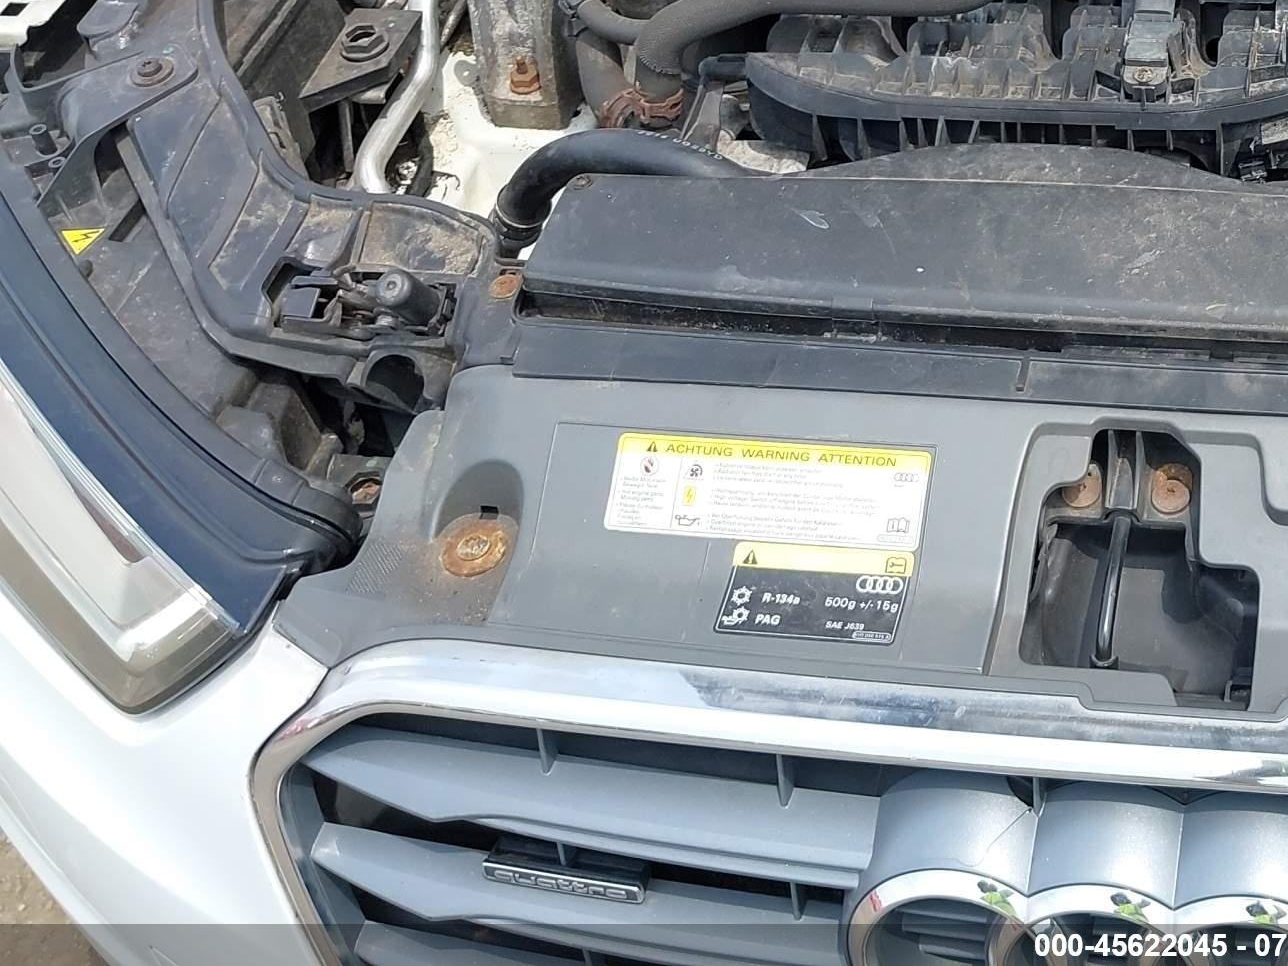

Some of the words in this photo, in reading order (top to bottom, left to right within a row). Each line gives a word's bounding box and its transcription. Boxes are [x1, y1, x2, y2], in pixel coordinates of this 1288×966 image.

[665, 443, 733, 457] ACHTUNG
[741, 448, 810, 462] WARNING
[817, 453, 897, 466] ATTENTION
[761, 592, 800, 605] R-134a
[825, 596, 856, 610] 500g
[876, 600, 899, 613] 15g
[755, 614, 781, 626] PAG
[825, 620, 843, 630] SAE
[844, 622, 865, 631] J639
[493, 870, 627, 899] quattro
